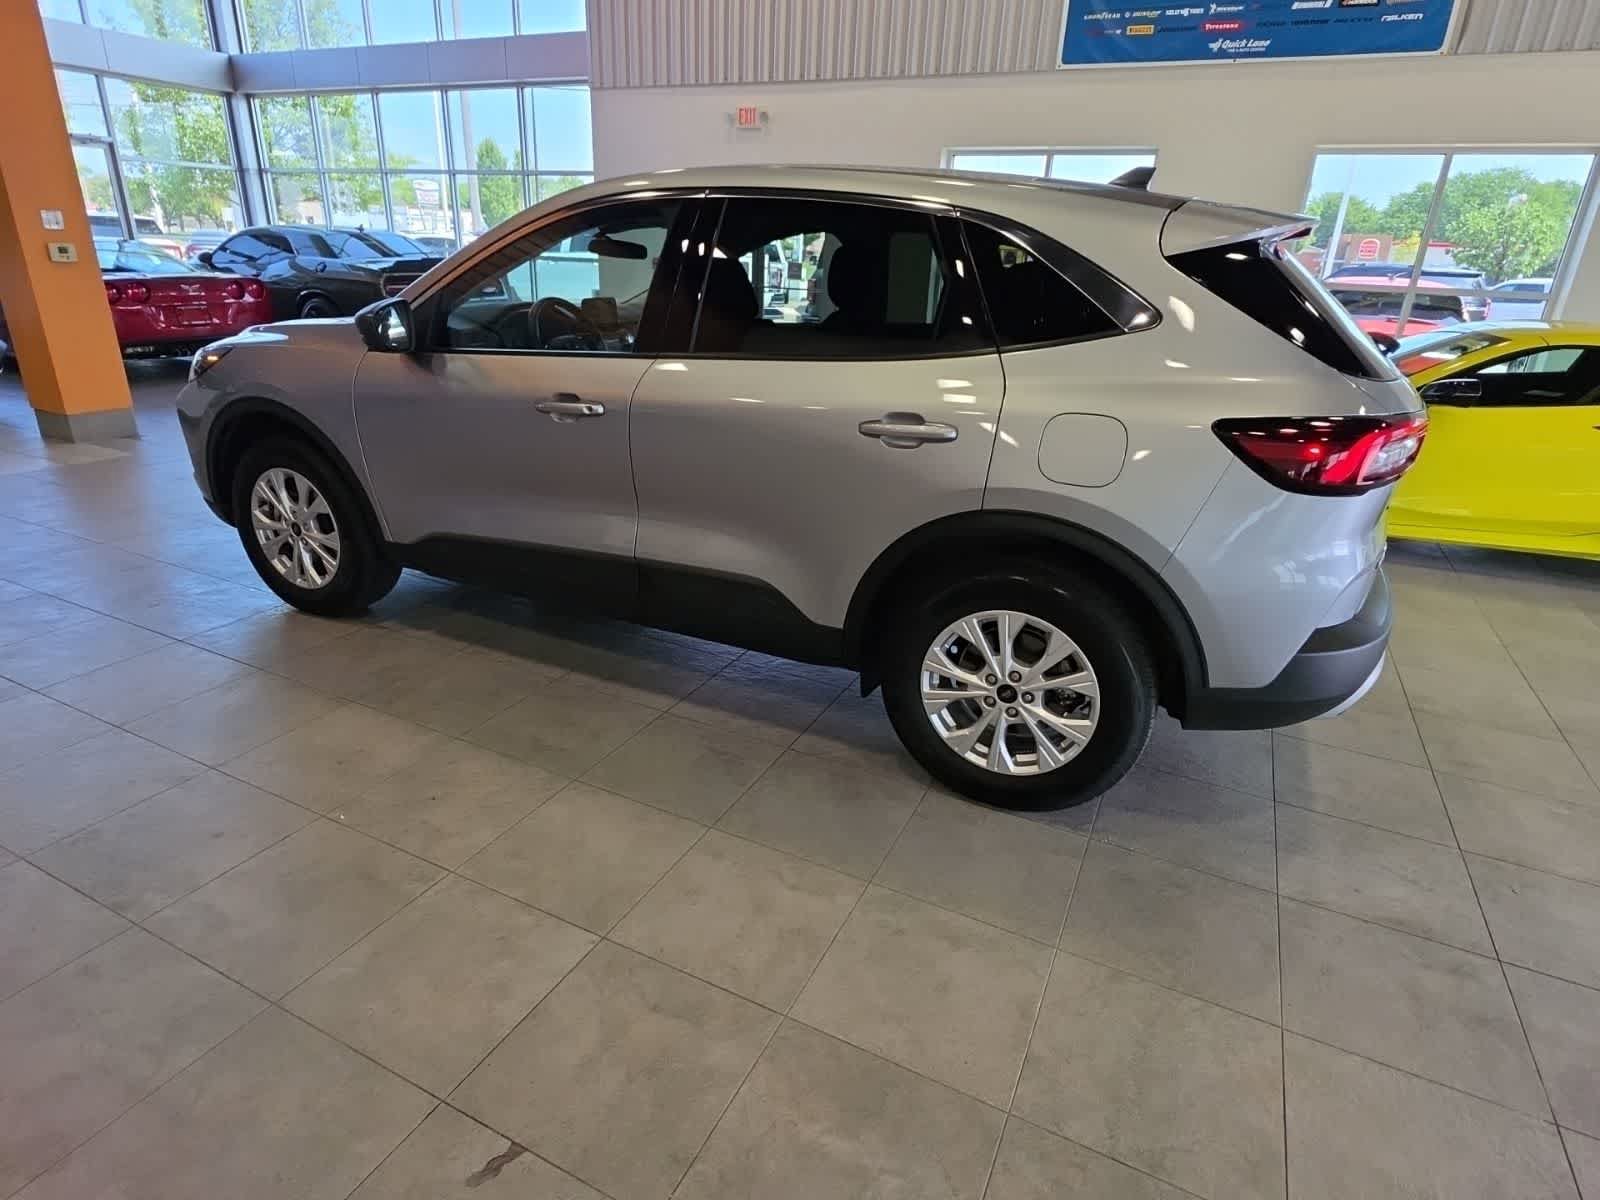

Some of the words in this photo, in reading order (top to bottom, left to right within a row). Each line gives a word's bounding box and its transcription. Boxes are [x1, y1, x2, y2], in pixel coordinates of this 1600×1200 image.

[1381, 13, 1424, 22] FALKEN
[1222, 39, 1247, 49] Quick
[1248, 39, 1271, 47] Lane
[738, 107, 757, 125] EXIT
